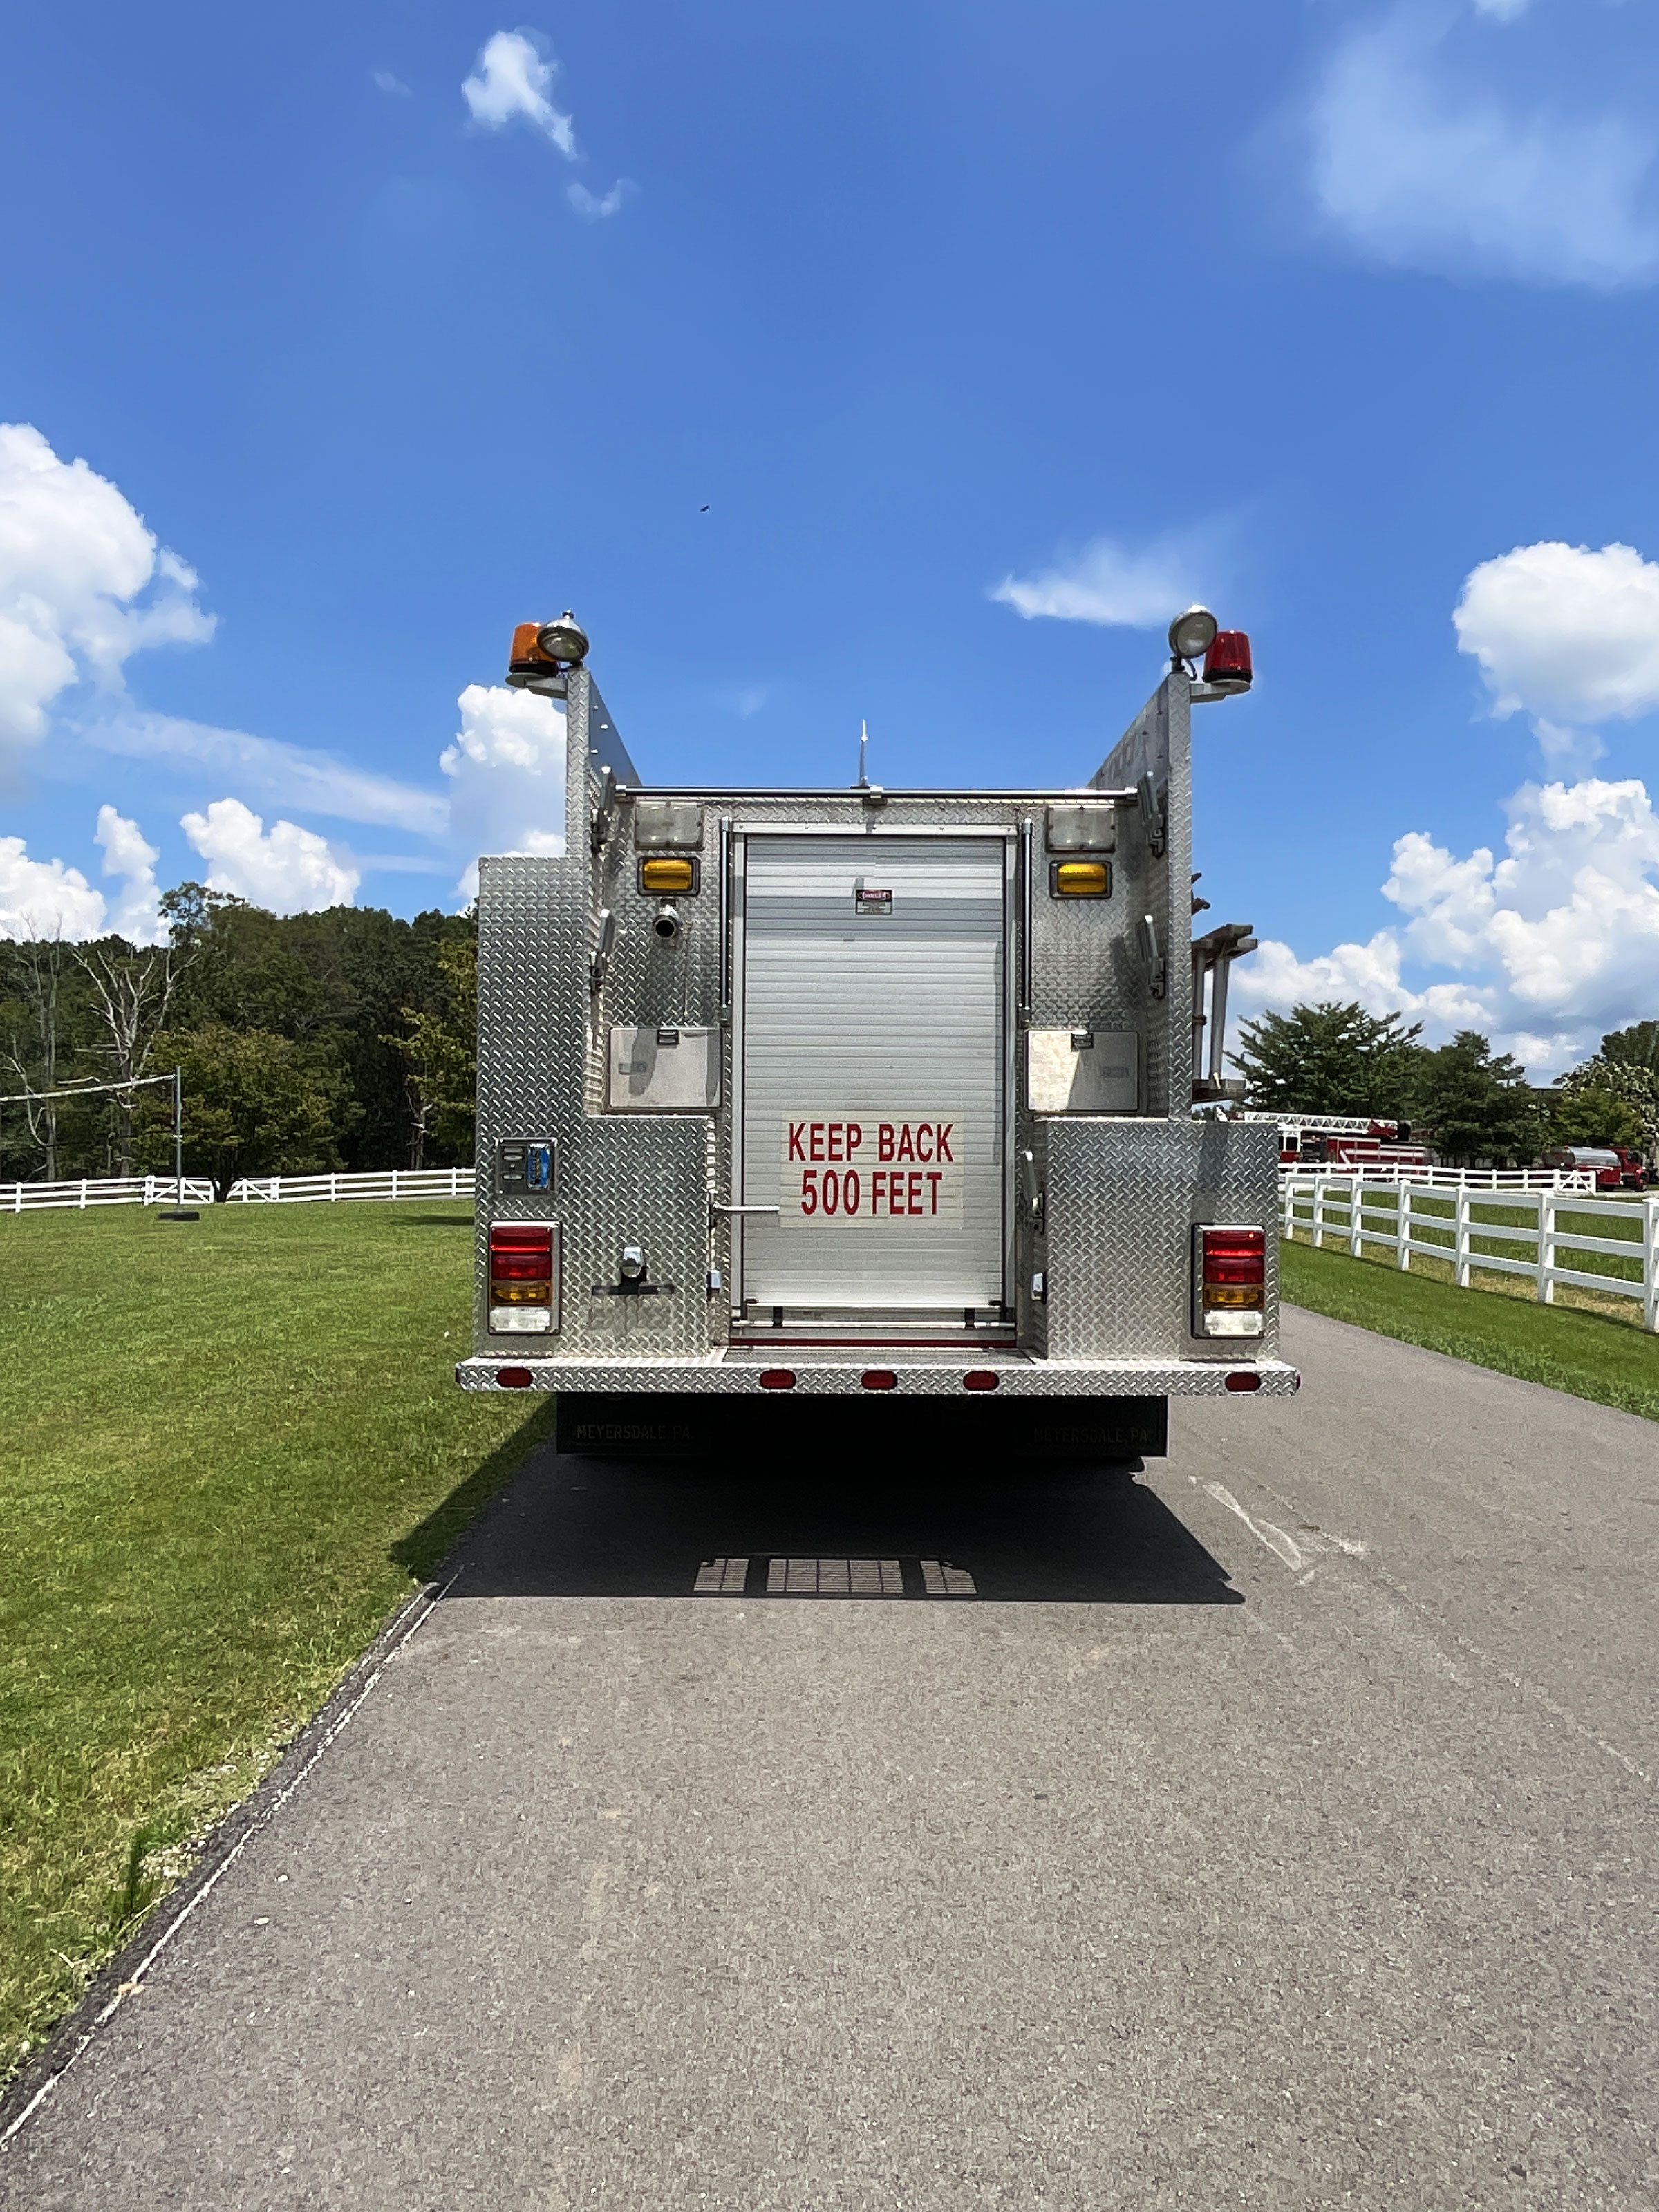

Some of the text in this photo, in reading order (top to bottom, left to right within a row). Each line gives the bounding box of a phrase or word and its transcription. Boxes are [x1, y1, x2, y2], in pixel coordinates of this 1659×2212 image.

[789, 1123, 954, 1162] KEEP BACK
[801, 1170, 943, 1215] 500 FEET
